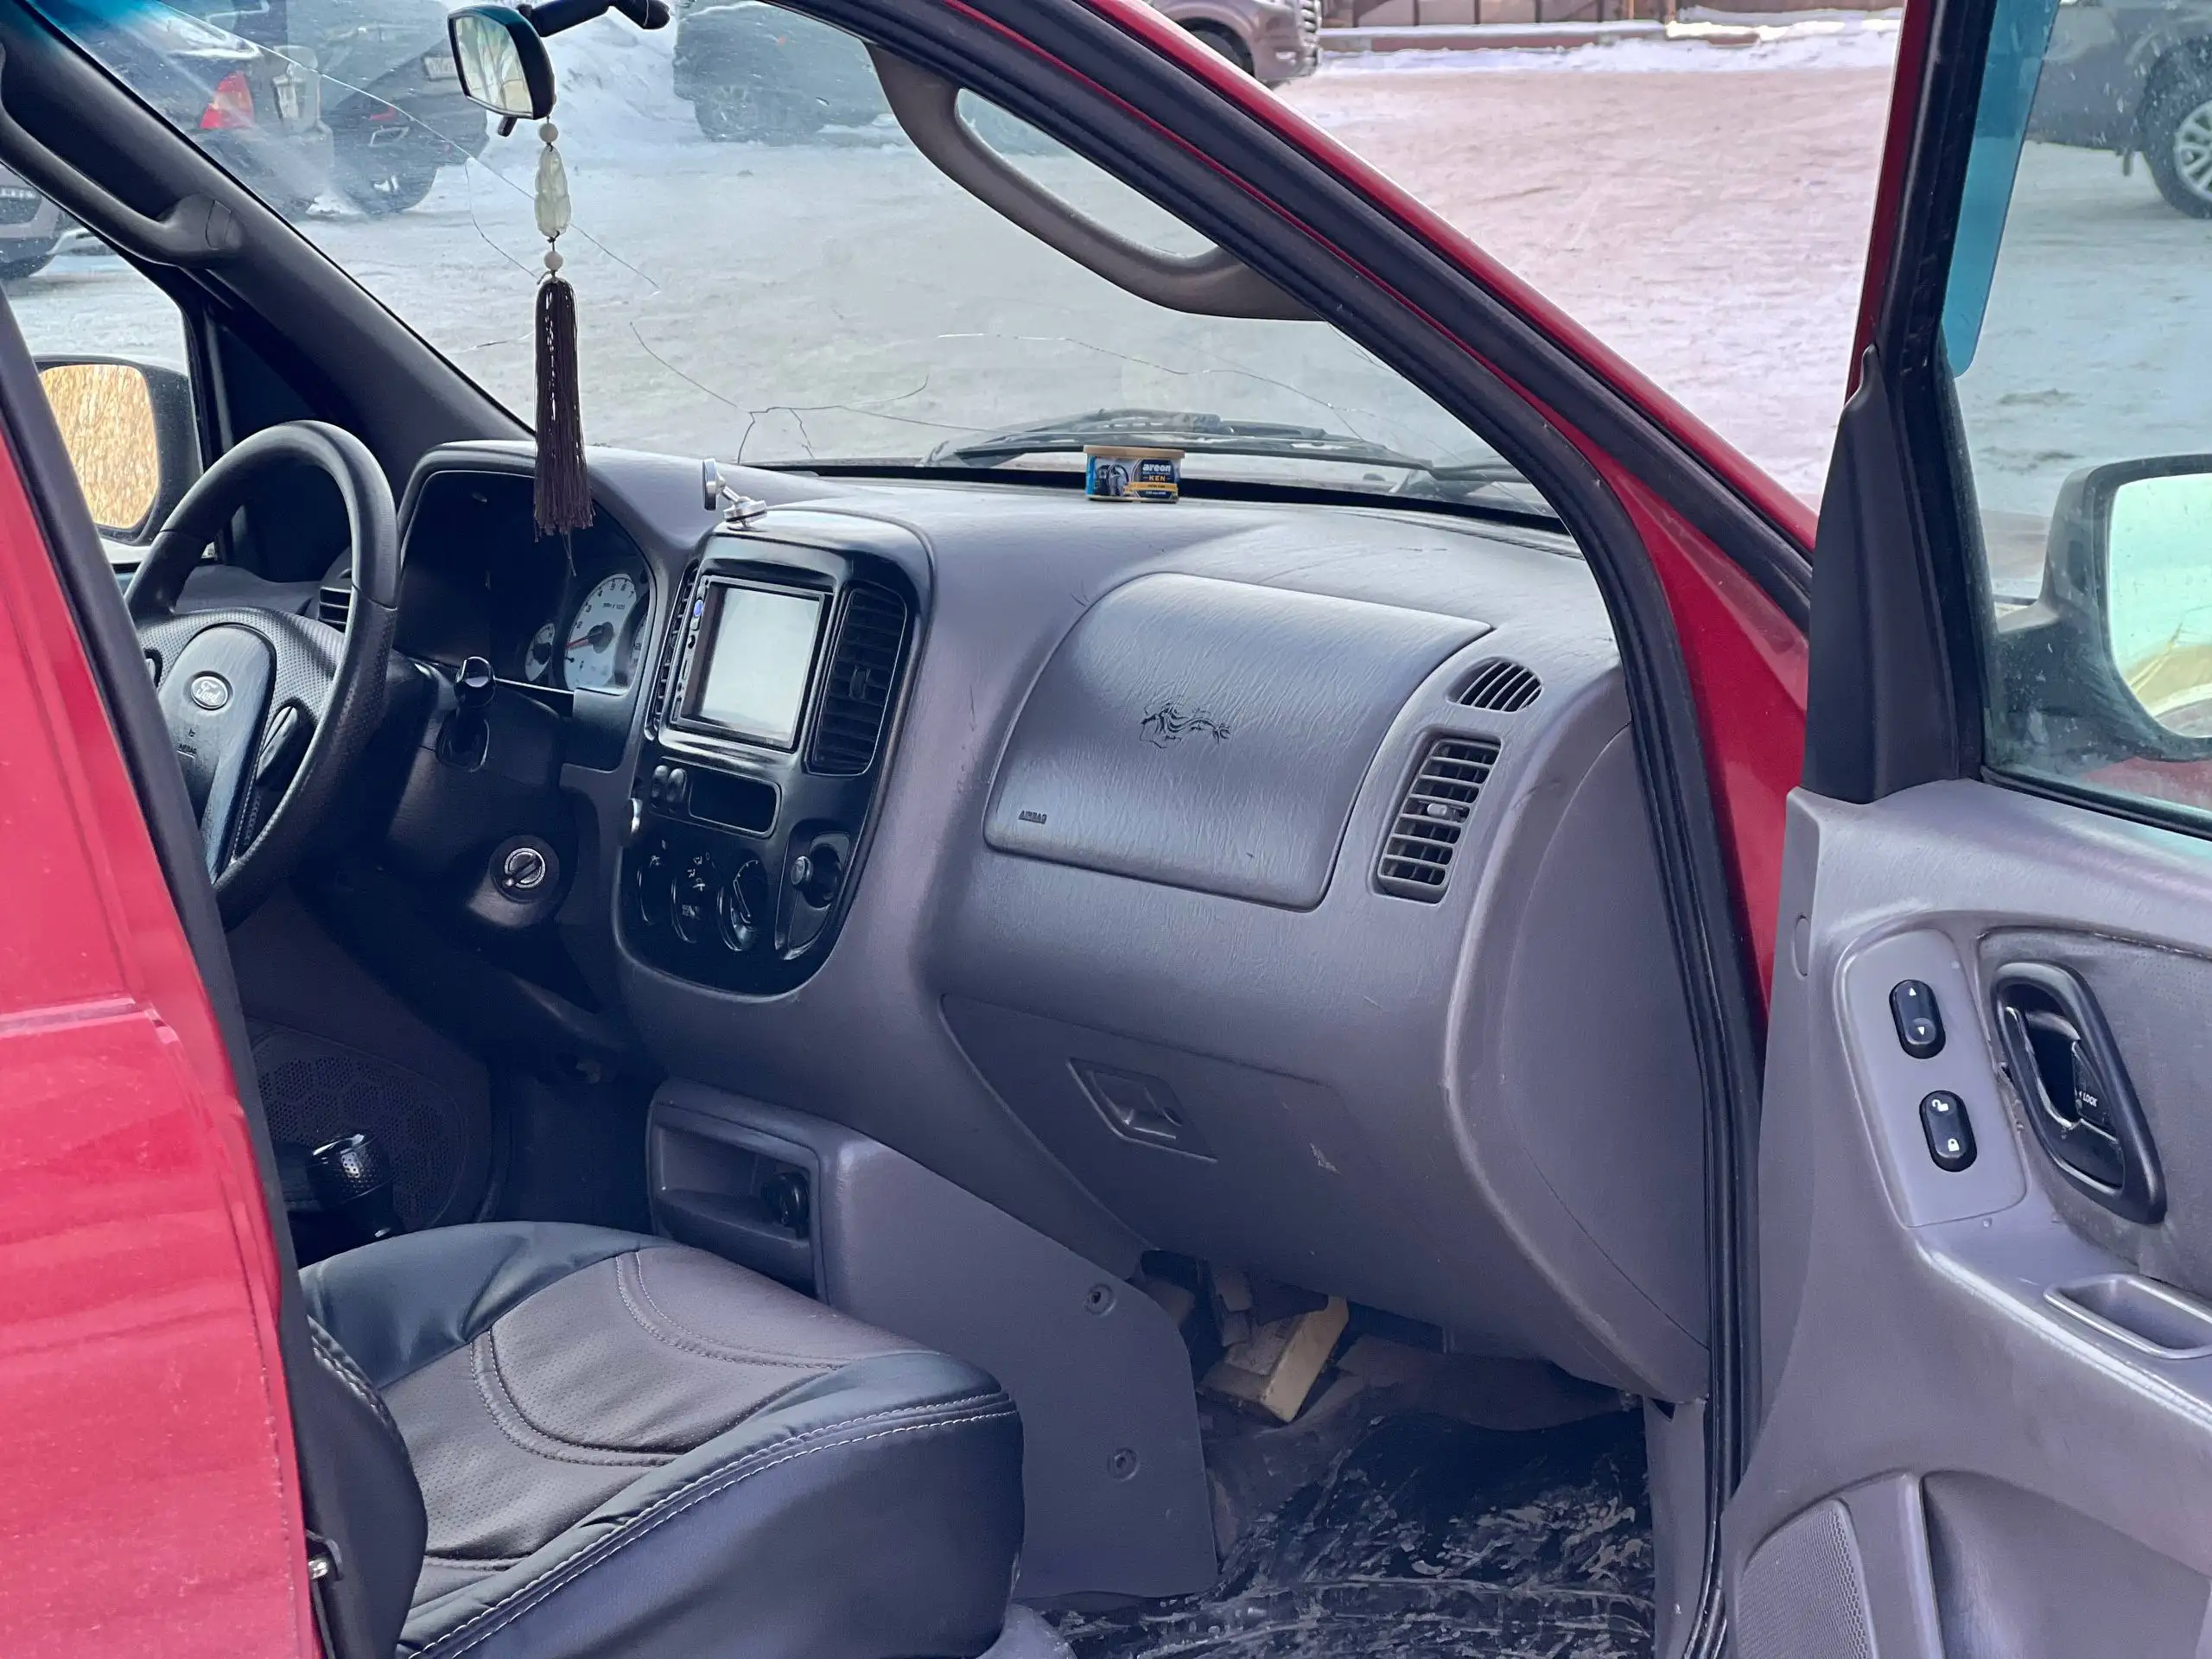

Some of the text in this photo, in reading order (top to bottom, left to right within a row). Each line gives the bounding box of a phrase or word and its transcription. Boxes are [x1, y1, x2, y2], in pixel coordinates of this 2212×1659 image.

[1142, 463, 1171, 472] areon
[195, 680, 221, 702] Ford
[2082, 1091, 2098, 1107] LOCK
